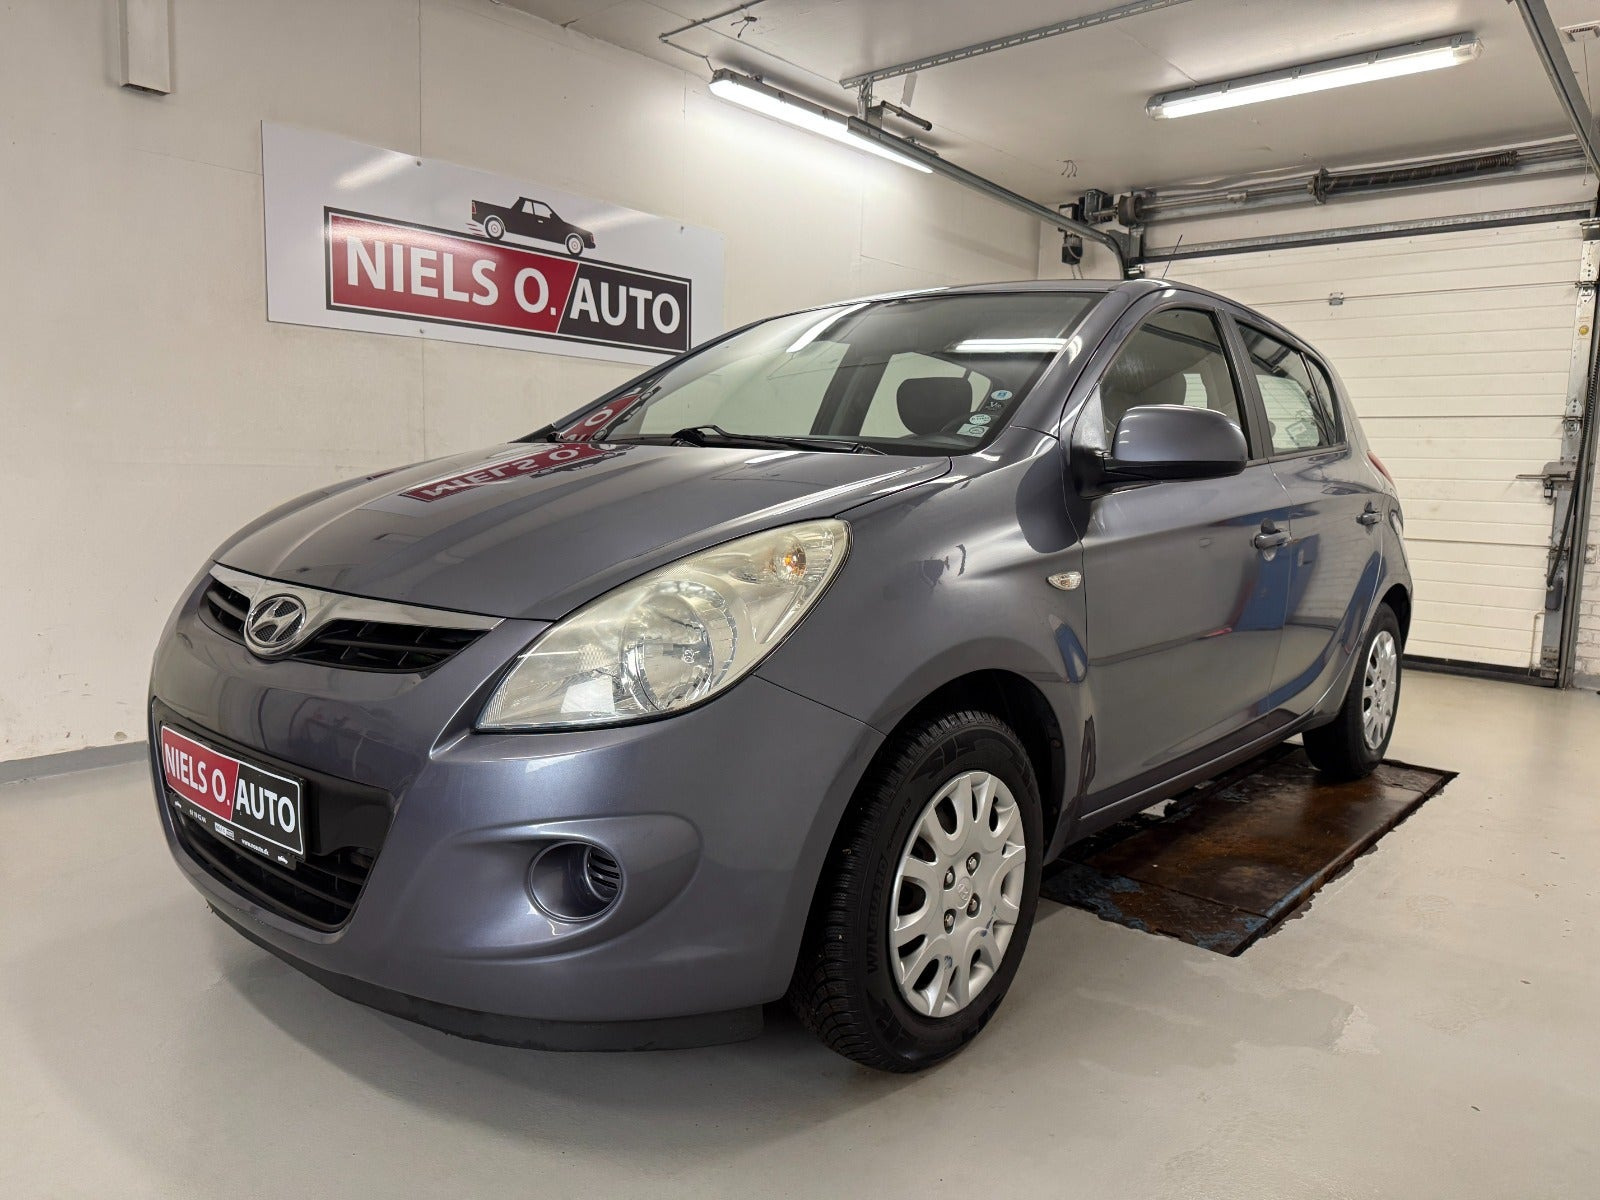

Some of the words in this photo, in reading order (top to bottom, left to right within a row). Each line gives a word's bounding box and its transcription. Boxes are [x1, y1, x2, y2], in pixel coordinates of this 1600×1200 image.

[346, 236, 498, 306] NIELS
[514, 268, 557, 316] O.
[569, 279, 681, 335] AUTO
[164, 743, 207, 794] NIELS
[211, 768, 230, 806] O.
[235, 778, 296, 833] AUTO
